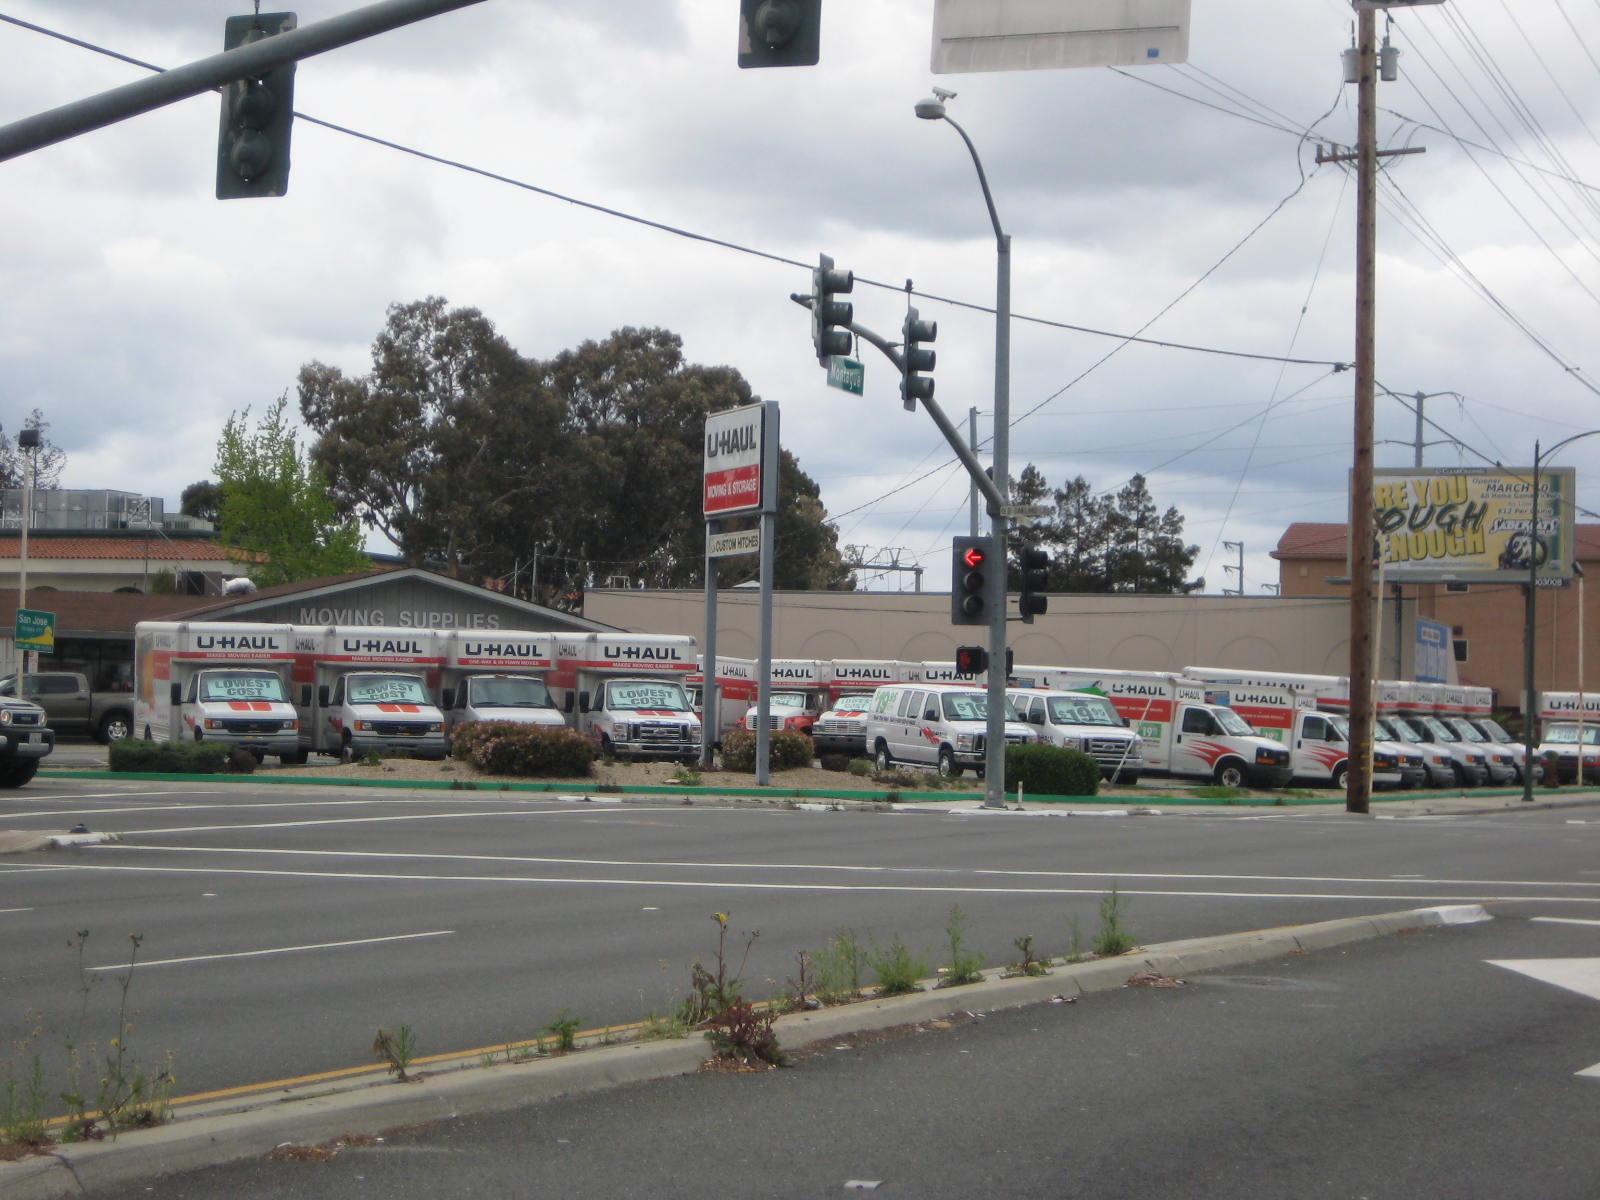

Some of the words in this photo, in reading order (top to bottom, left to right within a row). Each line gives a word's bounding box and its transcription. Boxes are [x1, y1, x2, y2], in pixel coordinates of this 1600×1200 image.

[707, 424, 757, 457] U-HAUL
[707, 483, 727, 498] MOVING
[728, 481, 732, 495] &
[733, 479, 757, 495] STORAGE
[1375, 482, 1409, 512] RE
[1412, 475, 1468, 508] YOU
[1487, 483, 1530, 492] MARCH
[1381, 501, 1488, 534] OUGH
[716, 538, 737, 552] CUSTOM
[738, 535, 759, 548] HITCHES
[19, 614, 31, 624] San
[32, 616, 48, 626] Jose
[300, 607, 385, 627] MOVING
[399, 611, 500, 630] SUPPLIES
[197, 636, 280, 650] U-HAUL
[344, 640, 423, 653] U-HAUL
[465, 643, 542, 657] U-HAUL
[604, 646, 682, 660] U-HAUL
[722, 665, 748, 677] U-HAUL
[836, 668, 891, 678] U-HAUL
[215, 680, 272, 688] LOWEST
[358, 682, 414, 696] LOWEST
[1112, 684, 1166, 696] U-HAUL
[227, 688, 264, 696] COST
[369, 691, 406, 700] COST
[619, 688, 673, 699] LOWEST
[630, 697, 666, 705] COST
[1235, 693, 1286, 704] U-HAUL
